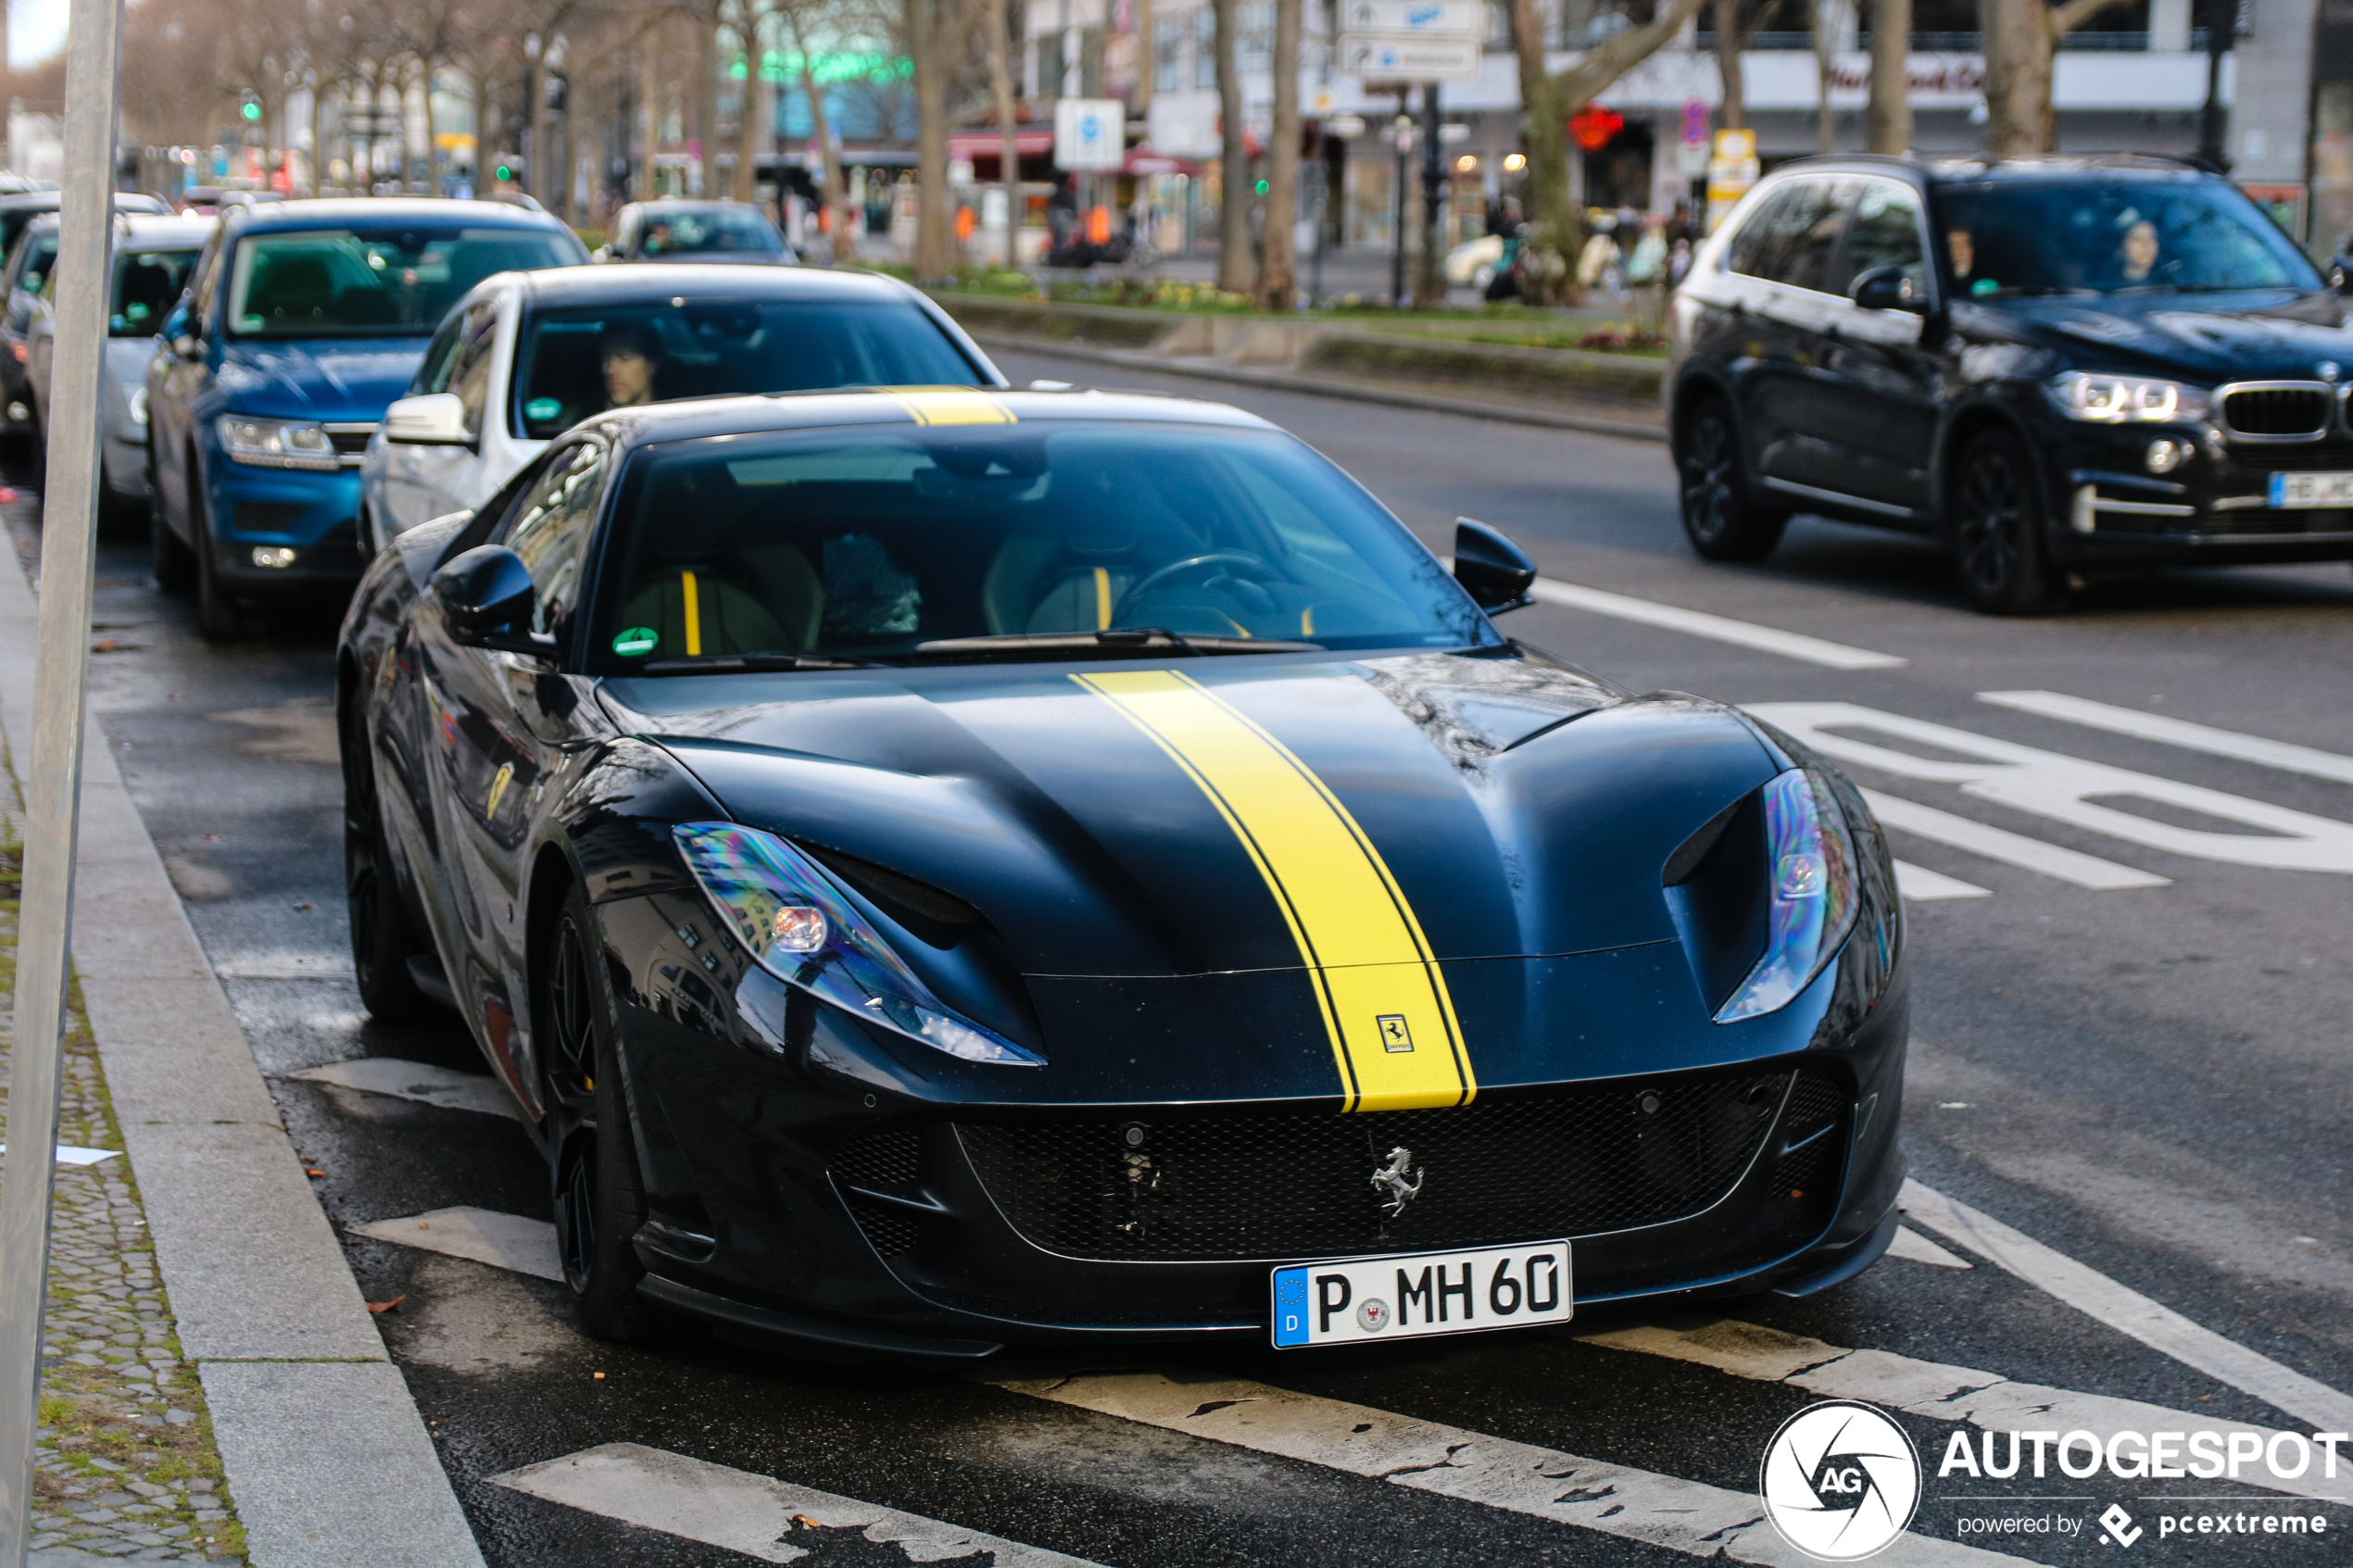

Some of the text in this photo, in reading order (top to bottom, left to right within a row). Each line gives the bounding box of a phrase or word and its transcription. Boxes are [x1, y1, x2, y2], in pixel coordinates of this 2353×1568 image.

[1315, 1273, 1352, 1333] P
[1397, 1261, 1474, 1325] MH
[1491, 1253, 1559, 1315] 60
[1286, 1315, 1299, 1332] D
